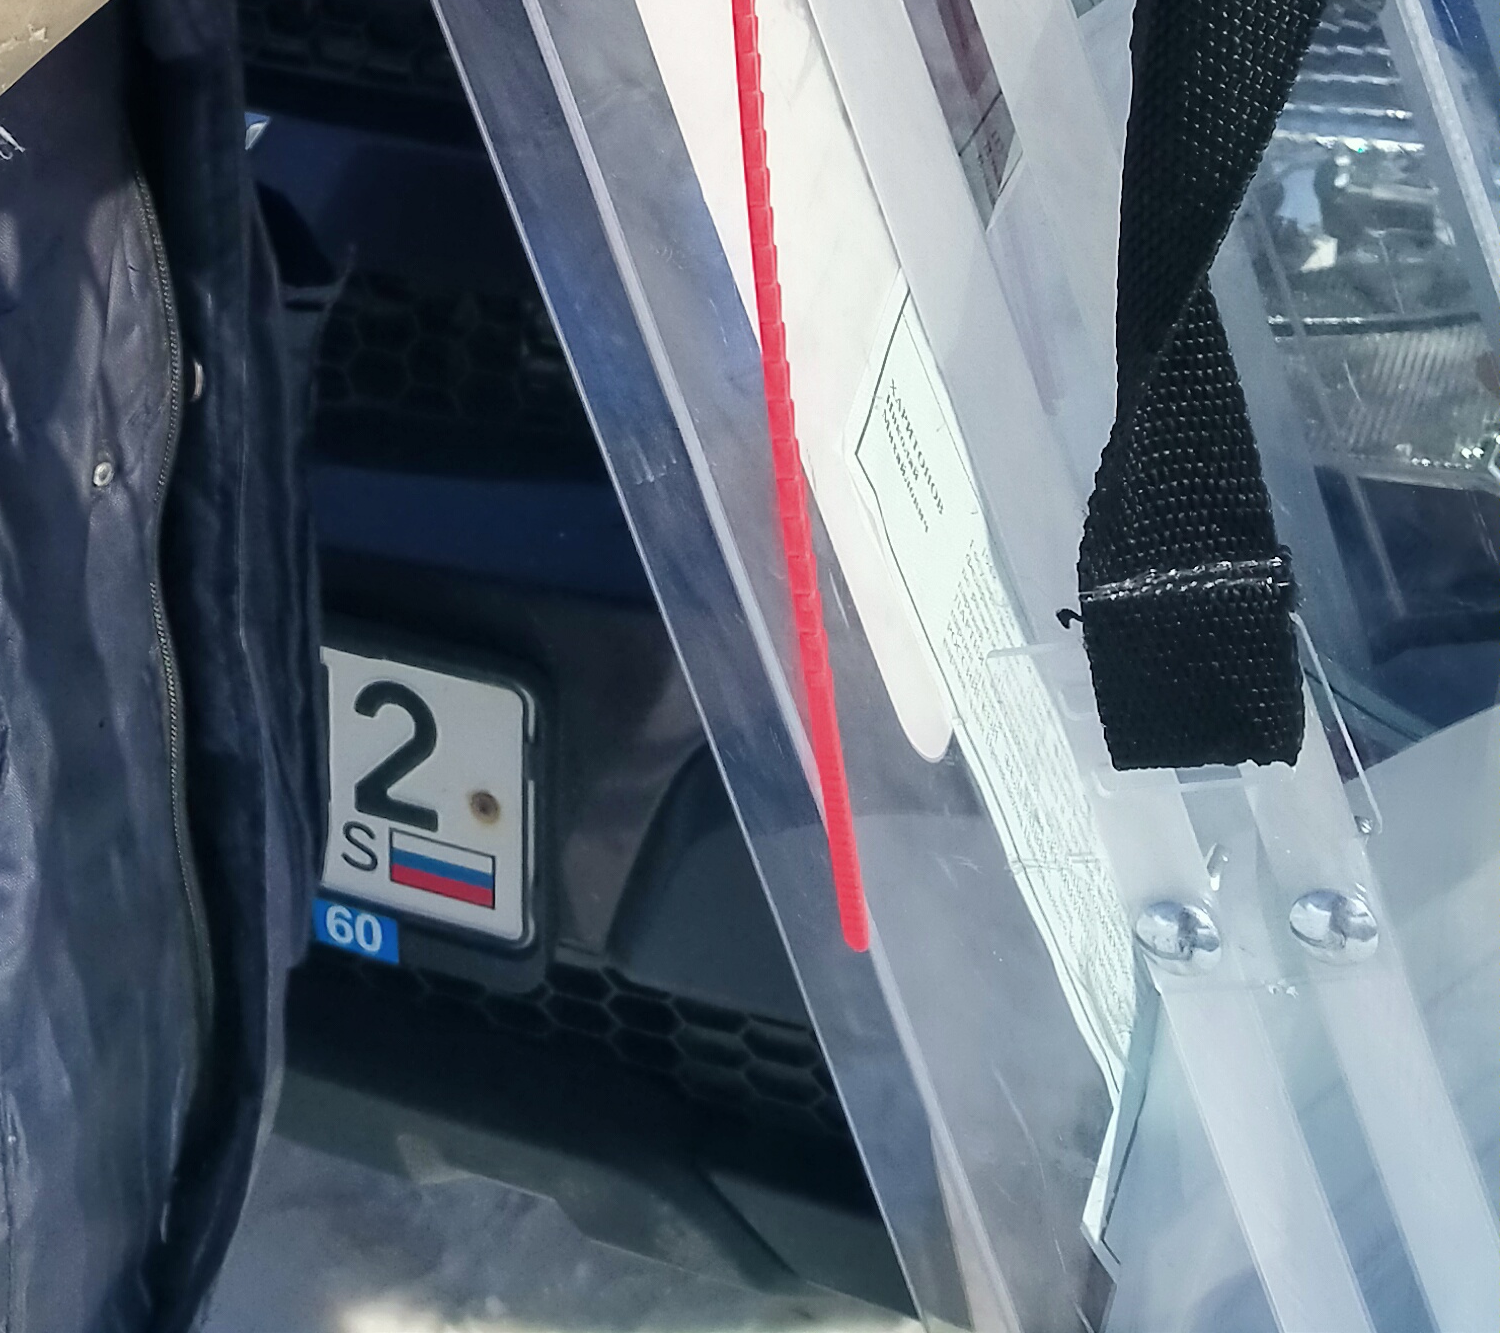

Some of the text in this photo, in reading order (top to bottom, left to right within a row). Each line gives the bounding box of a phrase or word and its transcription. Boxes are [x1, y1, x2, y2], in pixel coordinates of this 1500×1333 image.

[882, 407, 929, 534] Михайлович
[886, 393, 919, 482] Николай
[889, 377, 944, 516] ХАРИТОНОВ
[354, 680, 438, 832] 2
[341, 821, 379, 872] S
[325, 904, 384, 954] 60
